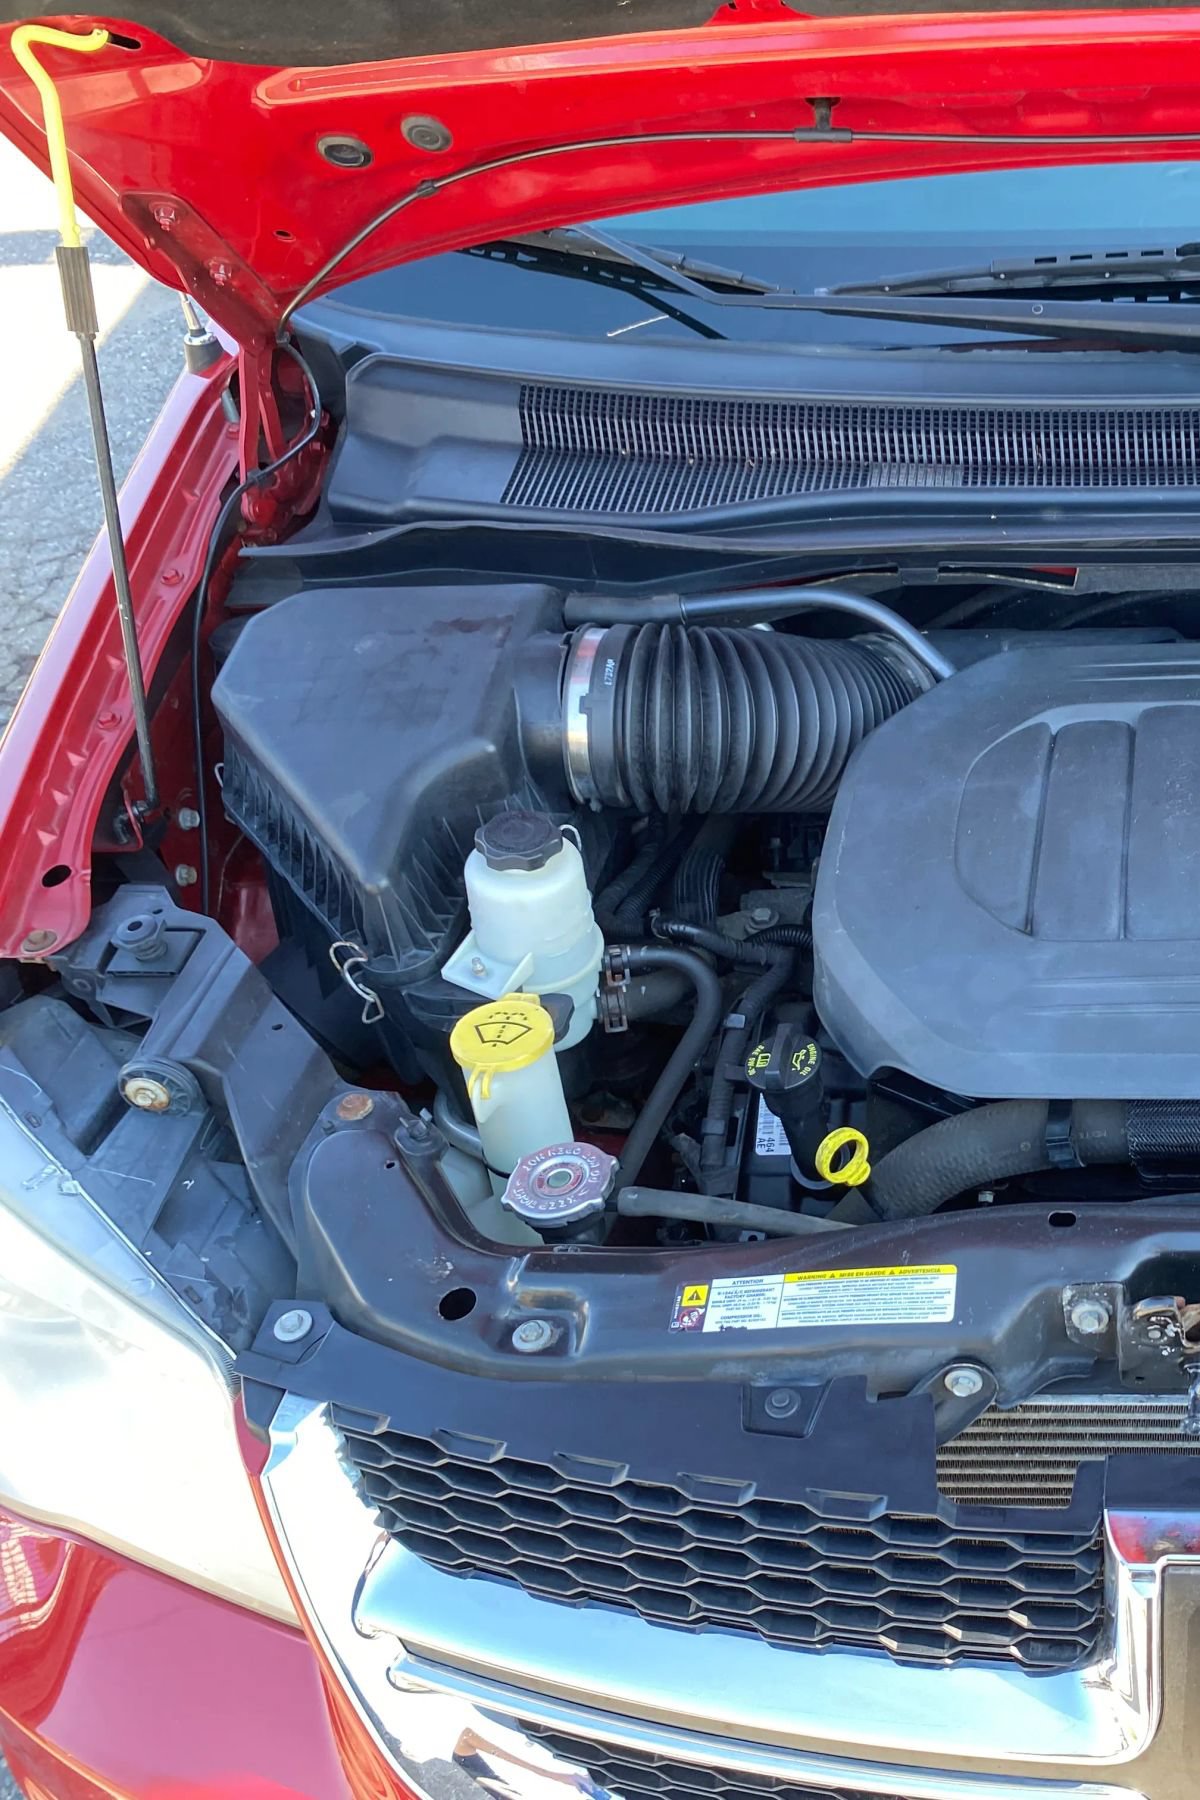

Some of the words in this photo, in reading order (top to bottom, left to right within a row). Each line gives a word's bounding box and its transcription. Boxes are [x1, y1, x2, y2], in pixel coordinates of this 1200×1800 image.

[806, 1043, 818, 1065] ENGINE
[799, 1065, 812, 1077] OIL
[756, 1137, 766, 1150] AE
[765, 1137, 776, 1153] 464
[797, 1273, 827, 1281] WARNING
[898, 1267, 941, 1275] ADVERTENCIA
